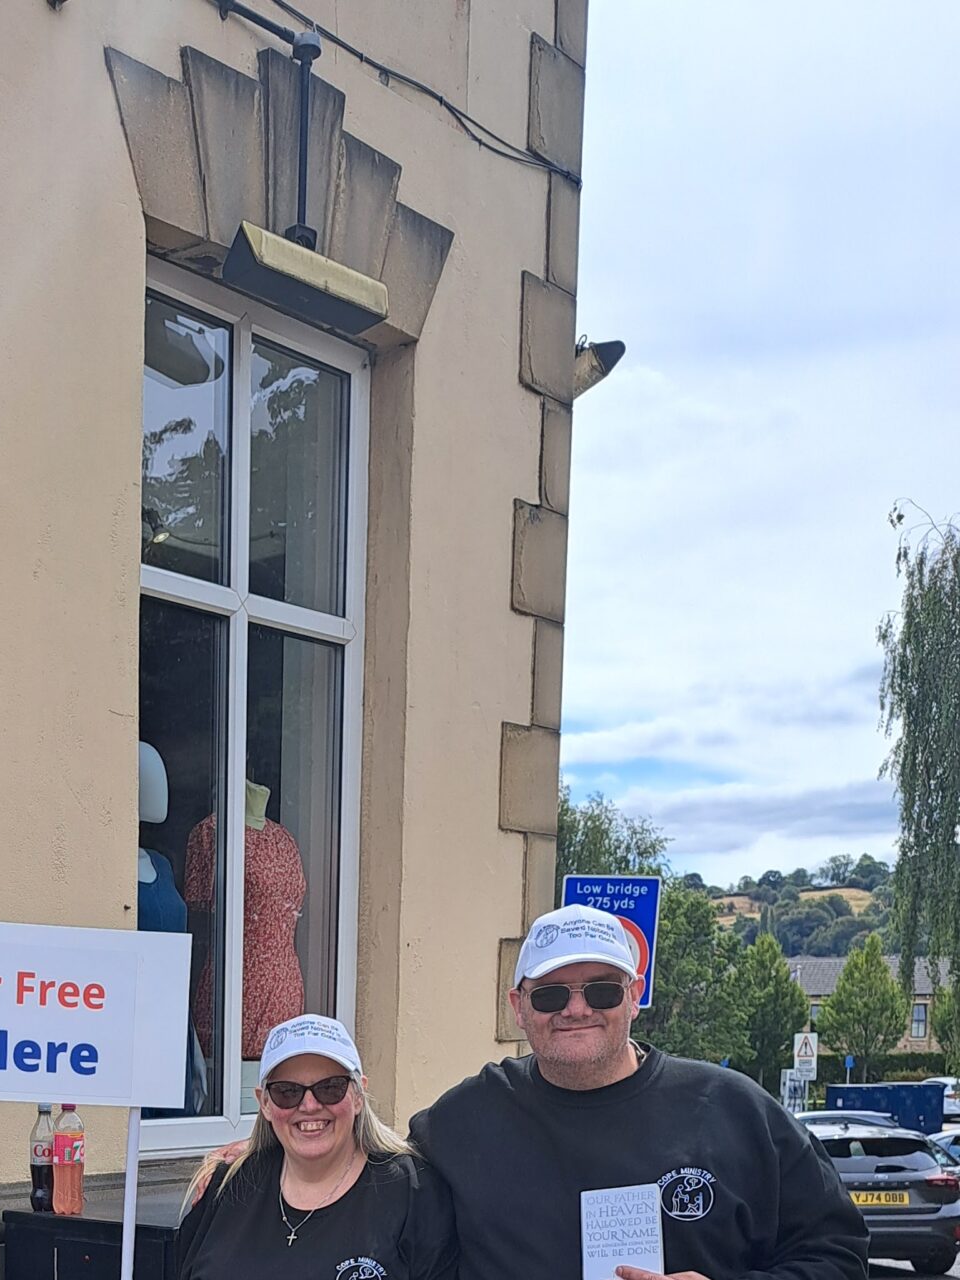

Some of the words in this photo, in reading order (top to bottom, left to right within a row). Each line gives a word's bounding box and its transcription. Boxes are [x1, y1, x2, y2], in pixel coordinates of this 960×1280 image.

[576, 882, 602, 894] Low
[607, 882, 648, 897] bridge
[587, 897, 611, 908] 275
[613, 897, 635, 911] yds
[16, 971, 106, 1010] Free
[657, 1170, 677, 1186] COPE
[680, 1167, 717, 1183] MINISTRY
[586, 1210, 596, 1219] IN
[599, 1201, 658, 1217] HEAVEN,
[586, 1216, 641, 1230] HALLOWED
[645, 1215, 658, 1225] BE
[586, 1230, 624, 1242] YOUR
[587, 1248, 608, 1258] WILL
[612, 1248, 625, 1257] BE
[336, 1259, 355, 1270] COPE
[358, 1256, 387, 1276] MINISTRY
